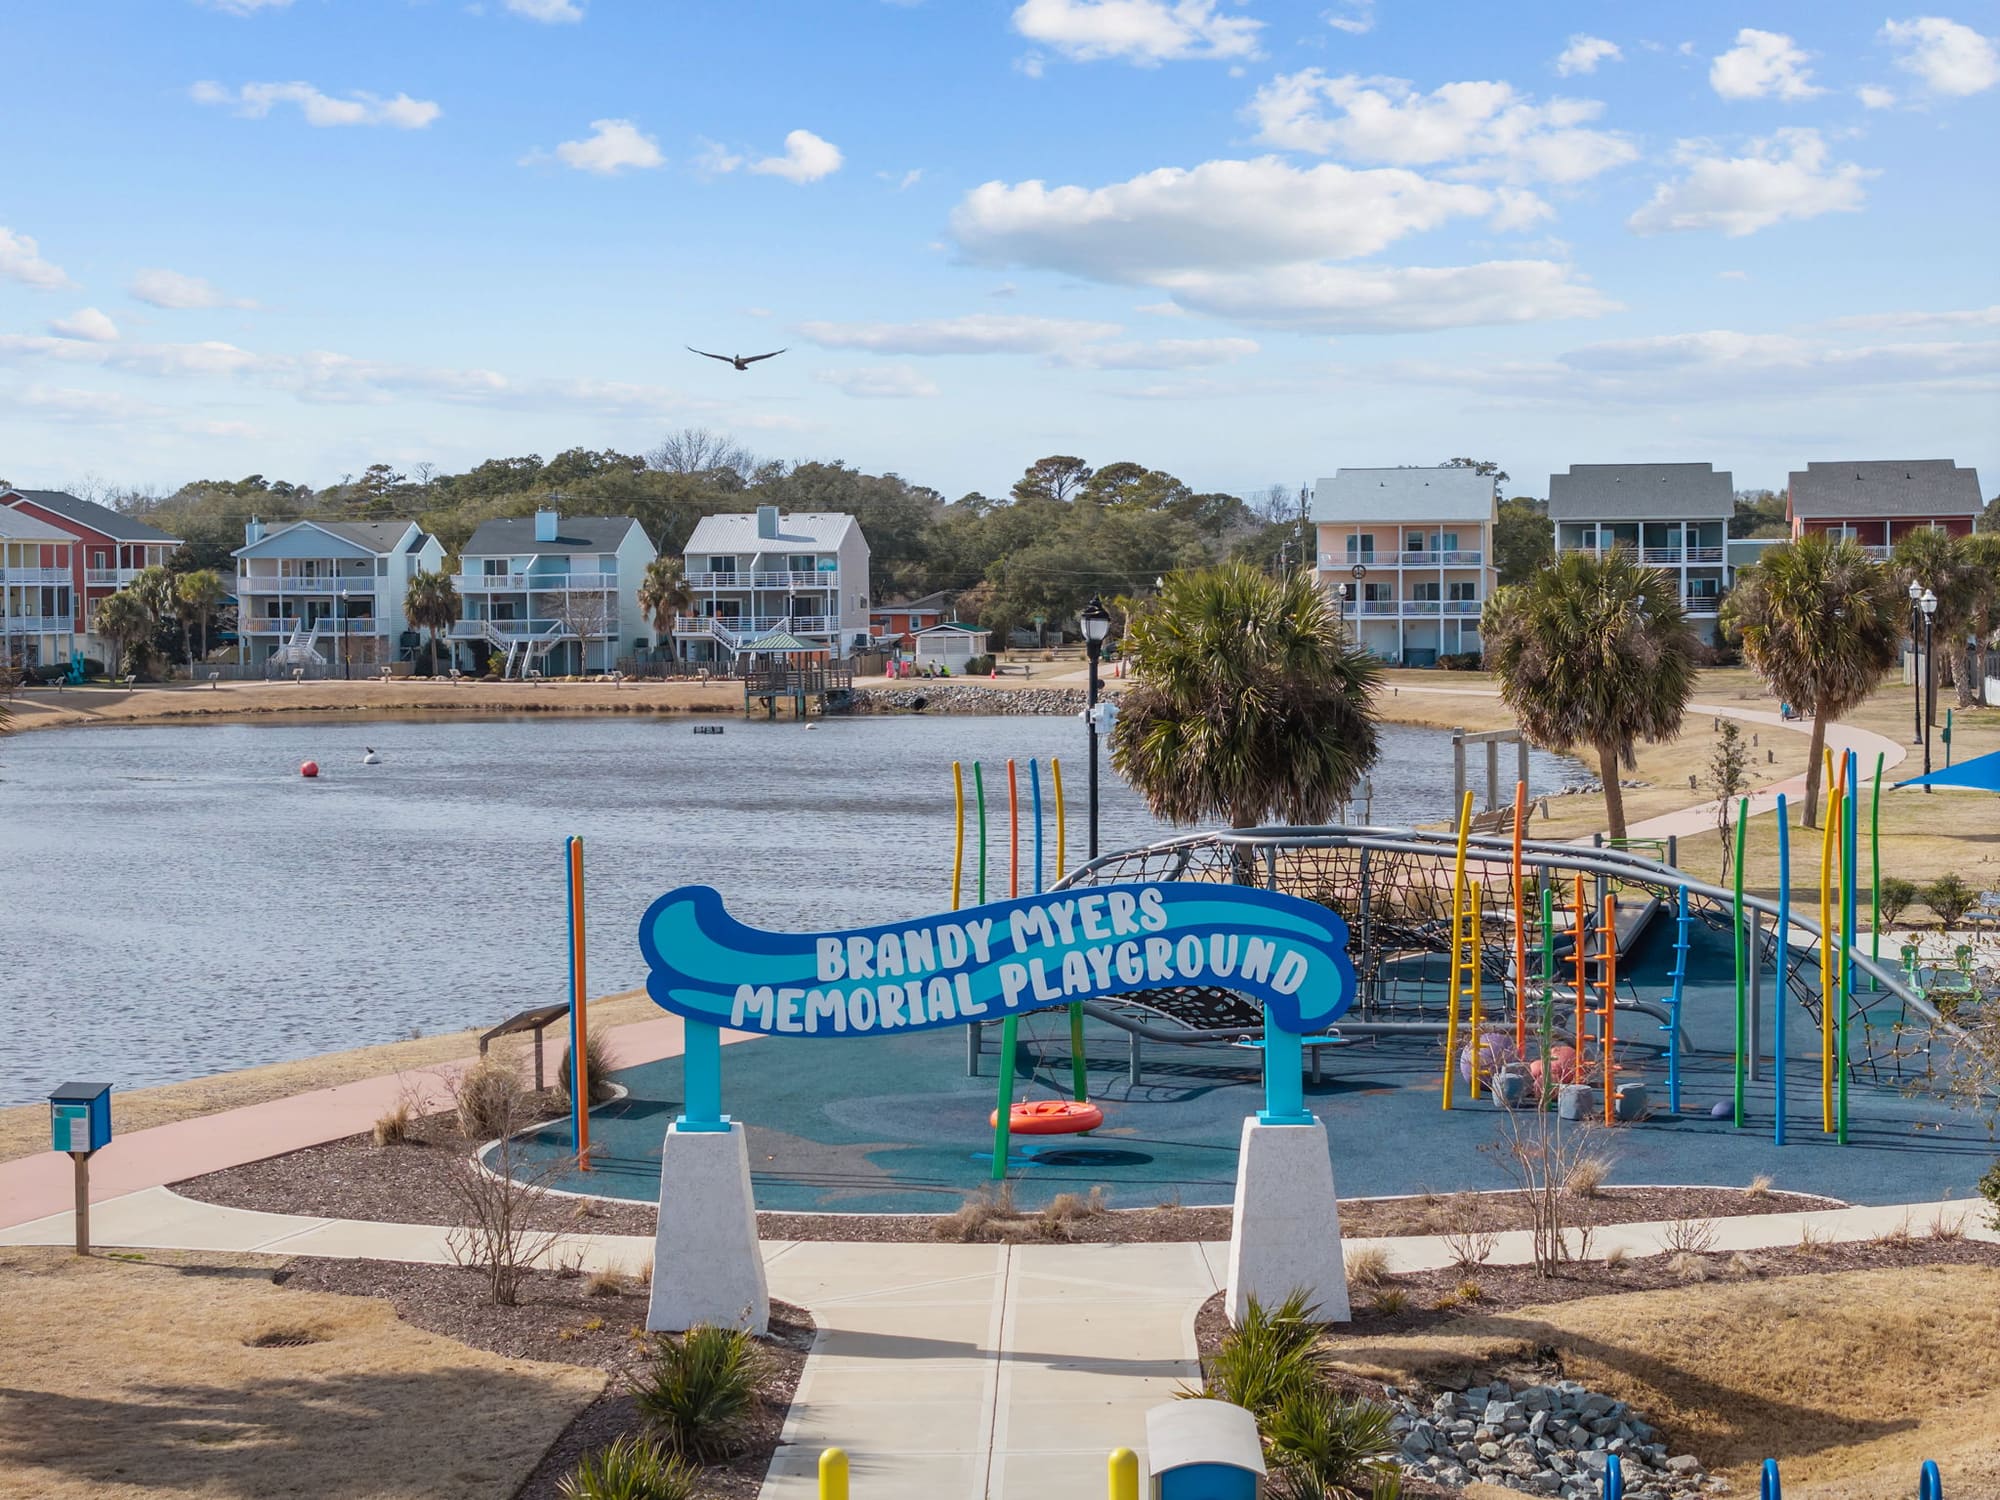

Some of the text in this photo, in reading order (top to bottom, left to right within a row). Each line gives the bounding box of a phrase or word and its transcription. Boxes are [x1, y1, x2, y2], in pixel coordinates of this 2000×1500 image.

[818, 887, 1168, 980] BRANDY MYERS
[731, 934, 1307, 1033] MEMORIAL PLAYGROUND
